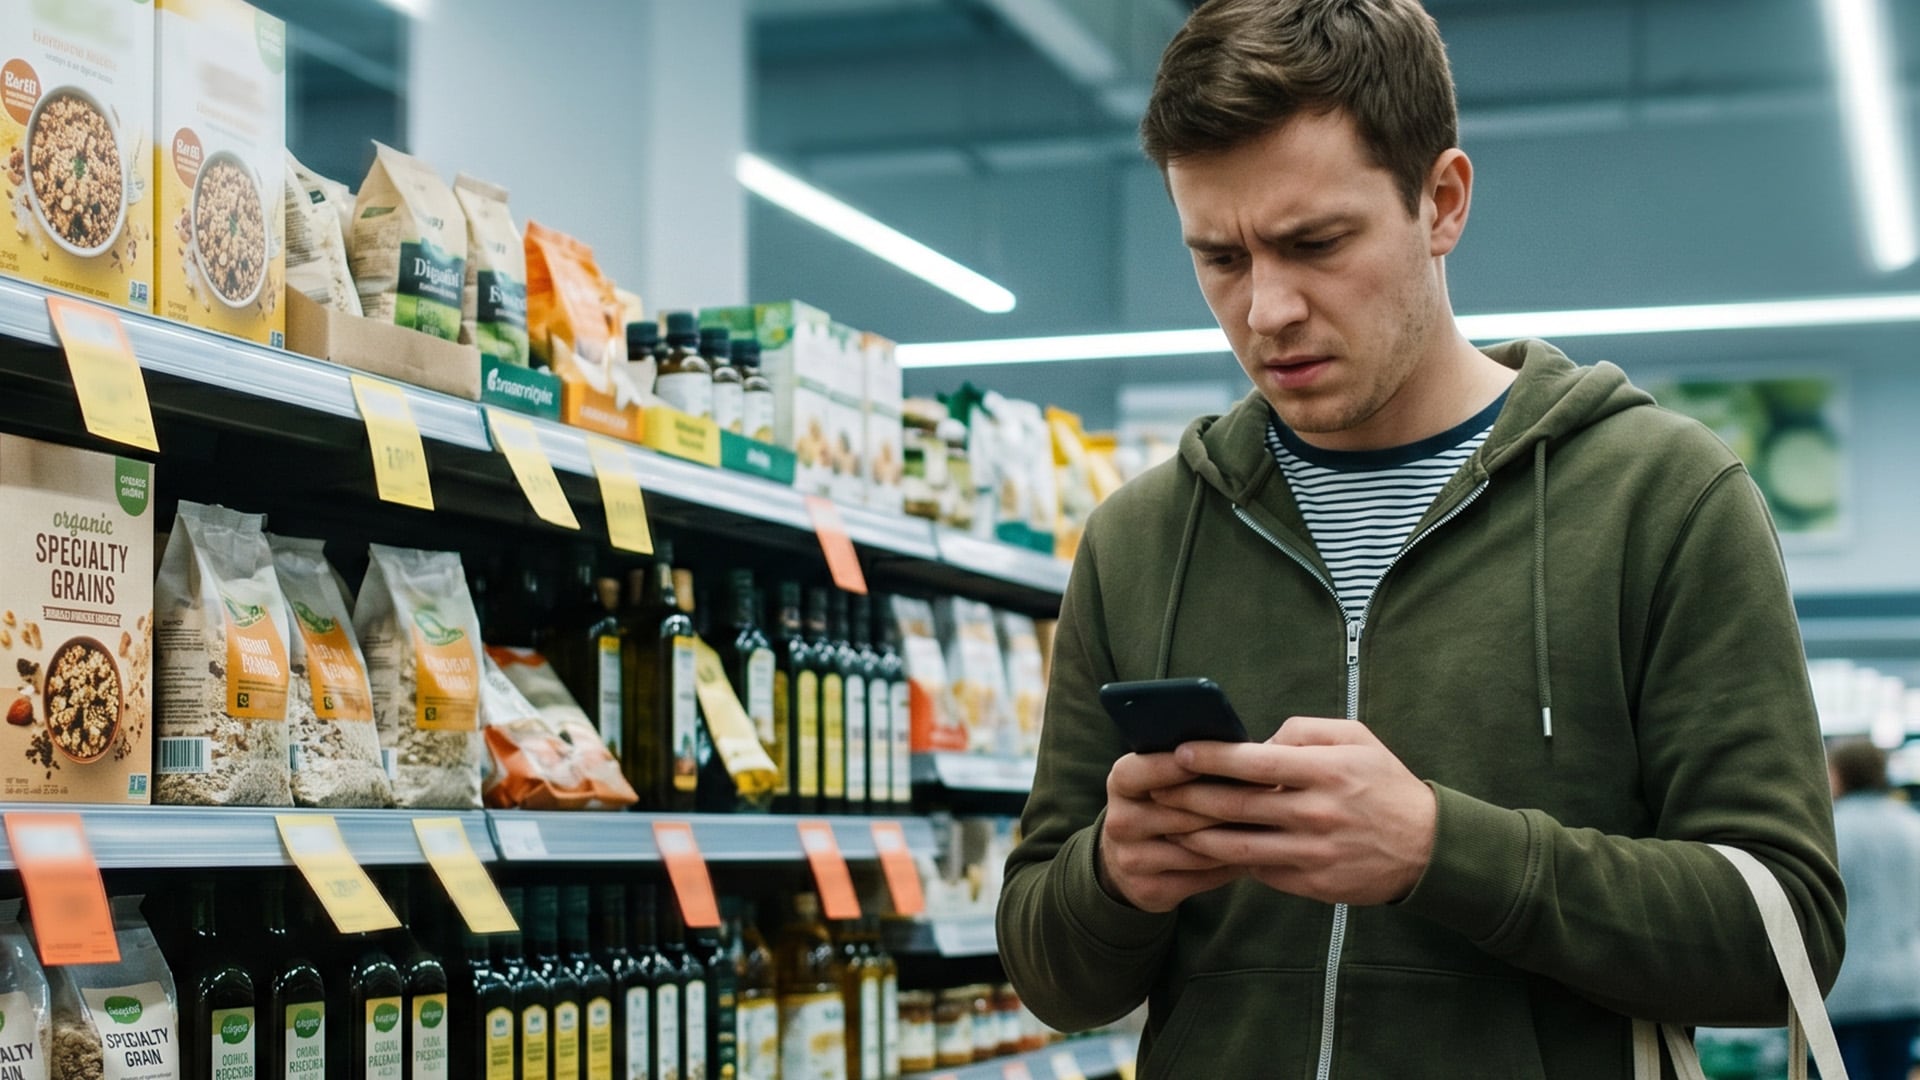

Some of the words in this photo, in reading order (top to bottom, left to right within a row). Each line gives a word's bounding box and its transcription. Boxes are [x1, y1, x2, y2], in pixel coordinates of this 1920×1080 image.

[53, 511, 114, 537] organic
[36, 532, 128, 574] SPECIALTY
[51, 569, 115, 605] GRAINS
[106, 1027, 169, 1049] SPECIALTY
[125, 1049, 163, 1068] GRAIN
